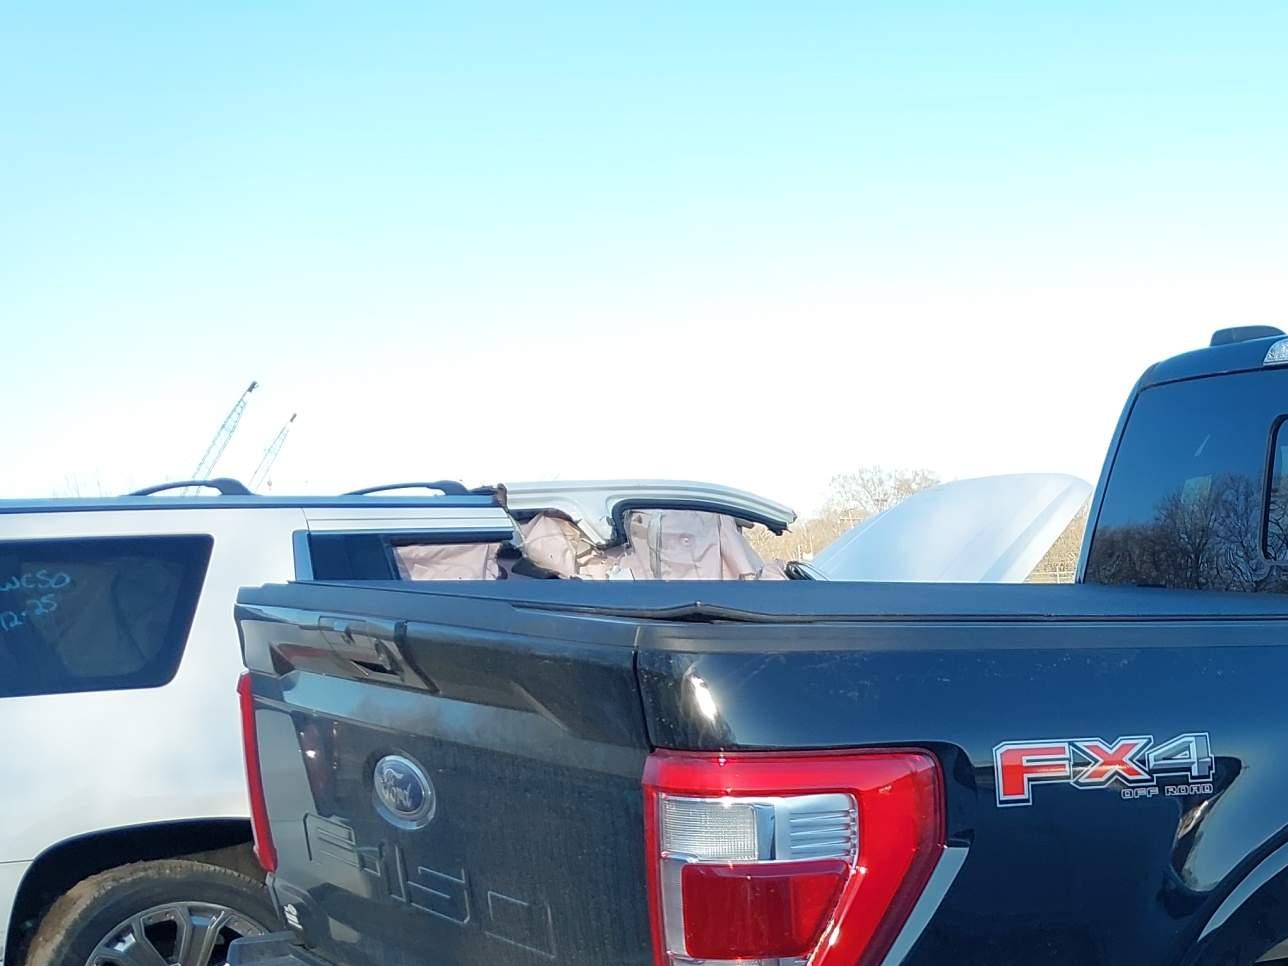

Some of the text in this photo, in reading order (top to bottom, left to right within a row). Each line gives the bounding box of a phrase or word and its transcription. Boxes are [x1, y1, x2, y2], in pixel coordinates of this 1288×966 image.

[993, 732, 1215, 807] FX4
[1121, 783, 1214, 799] OFF ROAD
